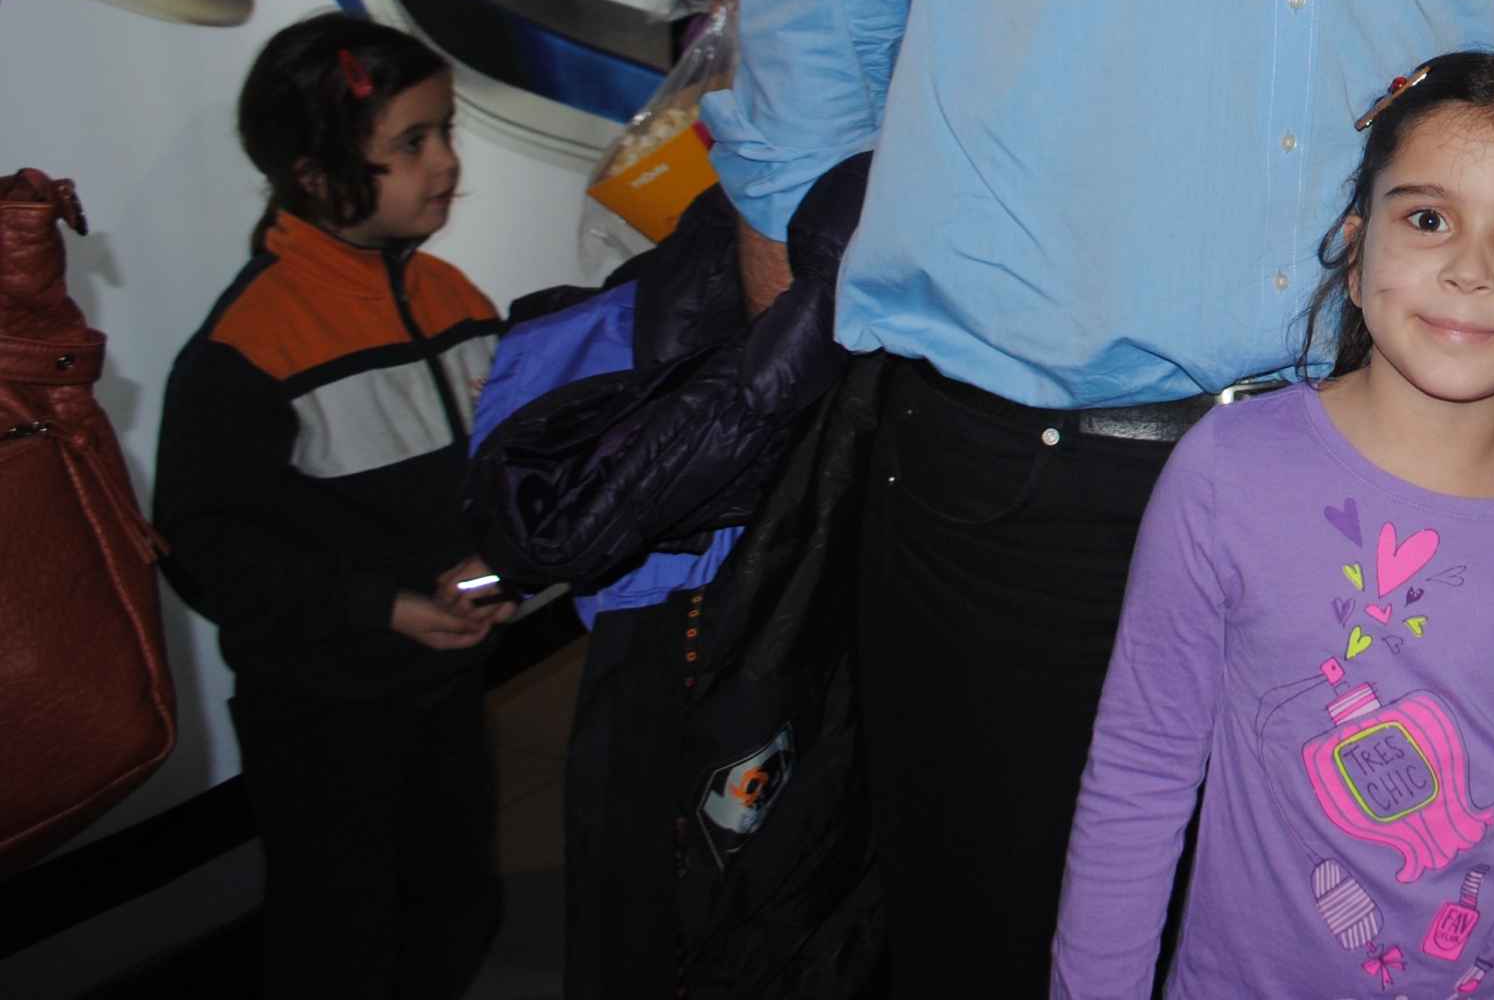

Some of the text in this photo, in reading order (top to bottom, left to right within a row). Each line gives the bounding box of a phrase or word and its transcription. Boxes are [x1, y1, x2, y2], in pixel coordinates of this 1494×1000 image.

[1342, 734, 1405, 776] TRES
[1366, 764, 1428, 811] CHIC
[1441, 907, 1470, 935] FAV
